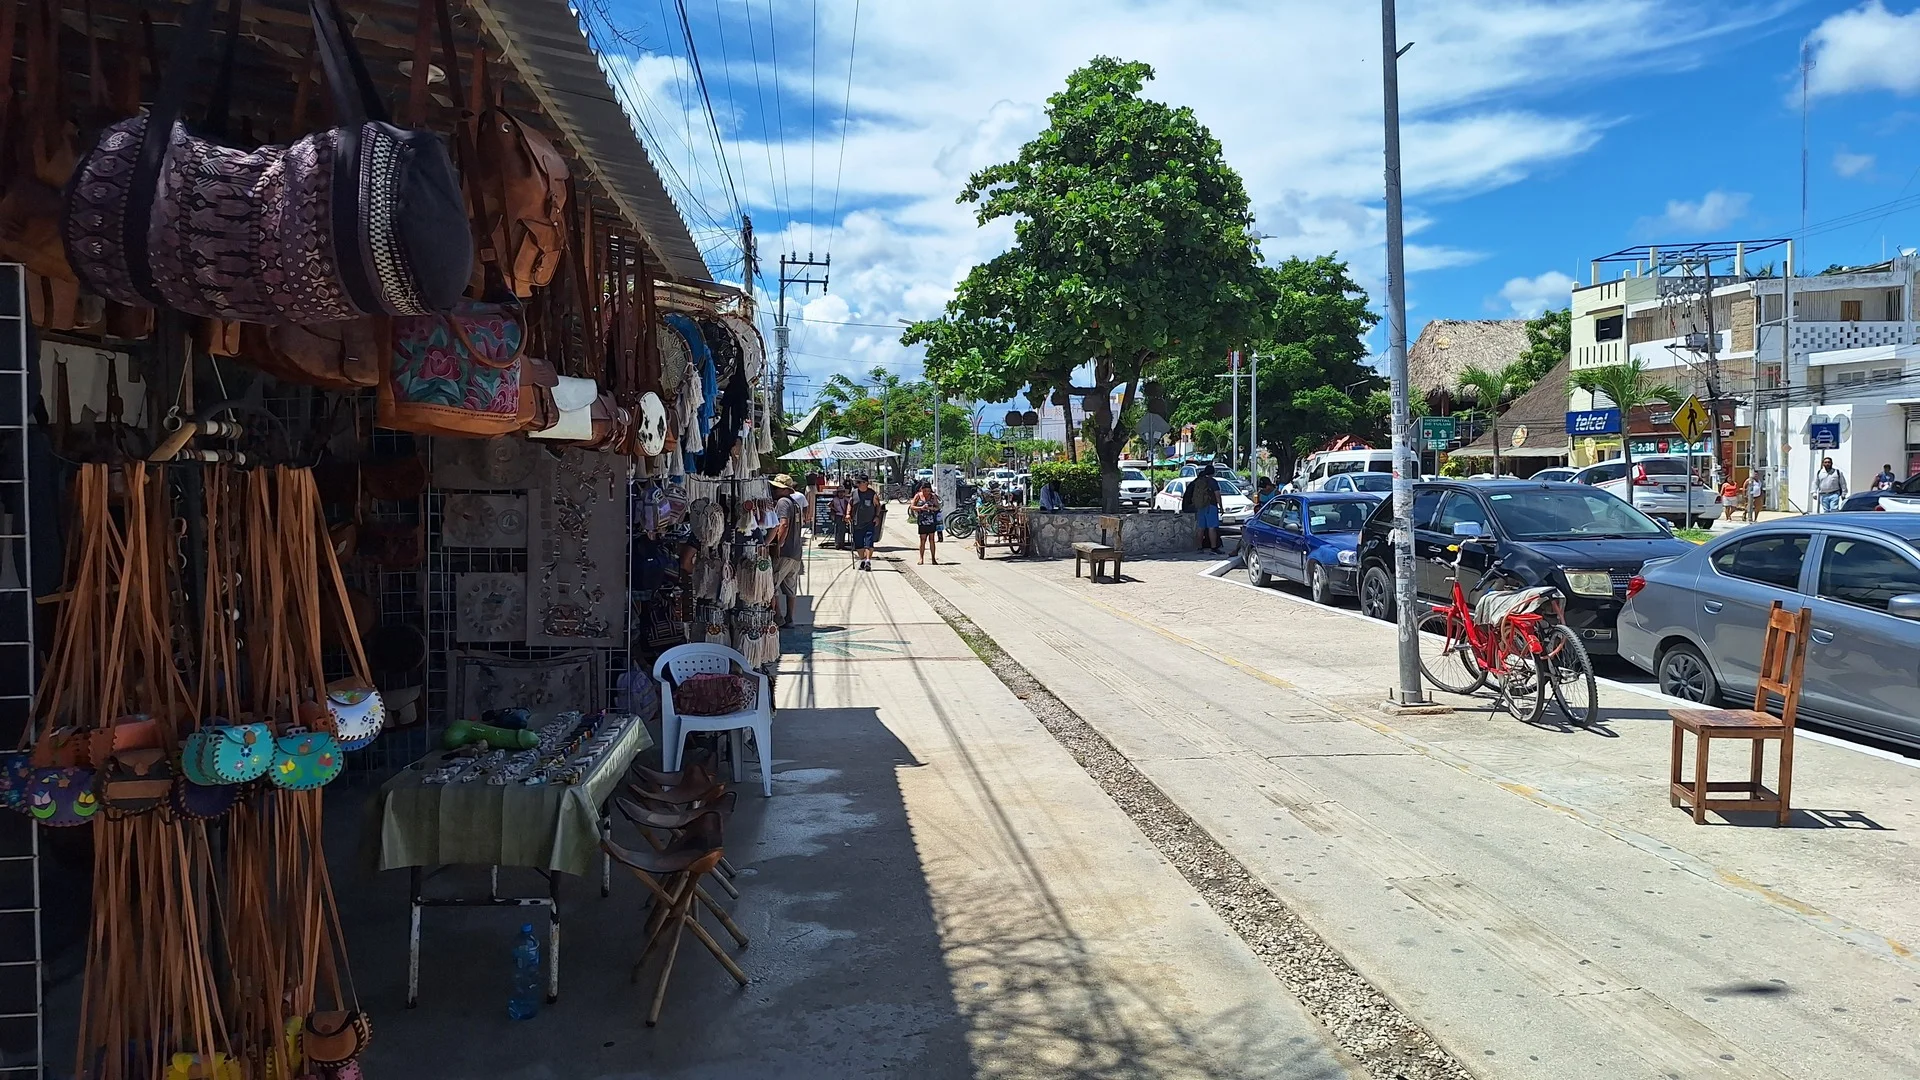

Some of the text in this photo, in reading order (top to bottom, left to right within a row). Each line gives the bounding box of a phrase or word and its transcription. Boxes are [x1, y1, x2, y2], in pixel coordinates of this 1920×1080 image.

[1575, 413, 1608, 431] telcel
[831, 450, 853, 459] DOS
[853, 448, 888, 459] EQUIS
